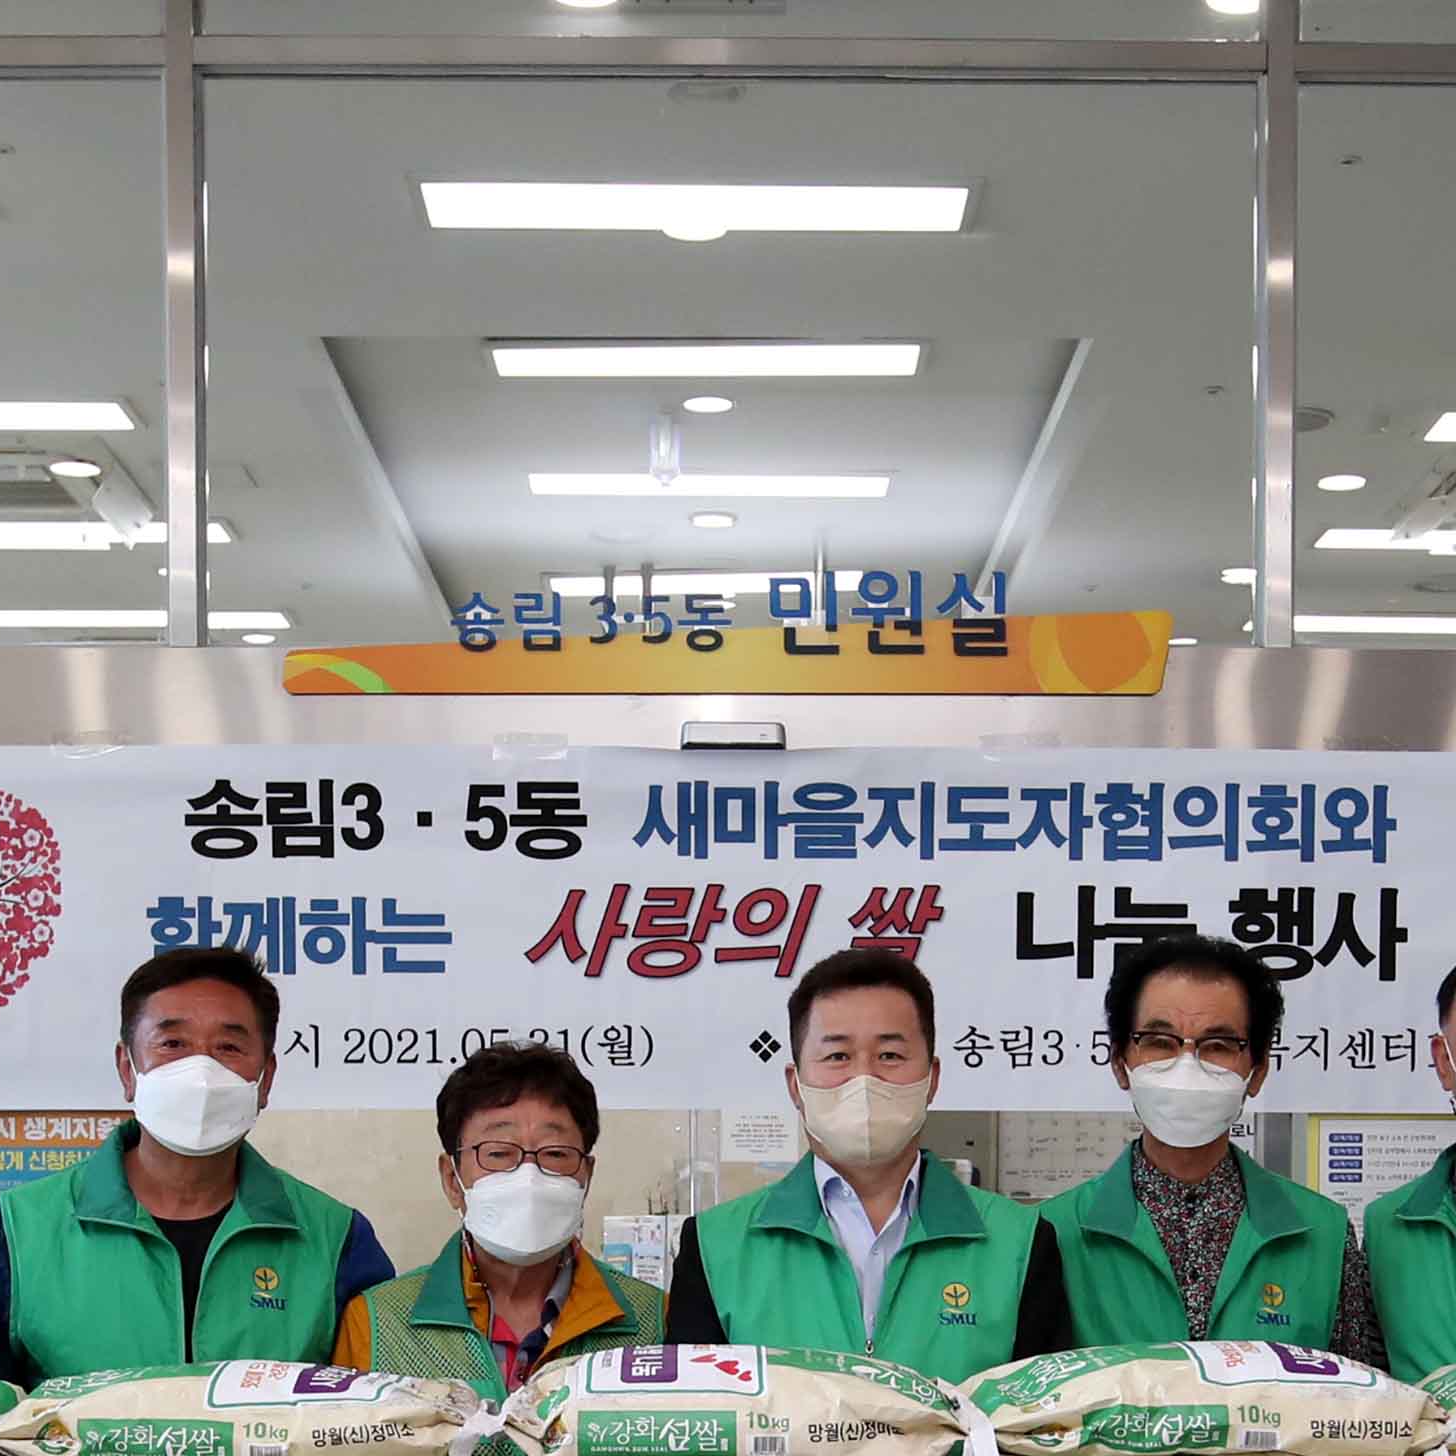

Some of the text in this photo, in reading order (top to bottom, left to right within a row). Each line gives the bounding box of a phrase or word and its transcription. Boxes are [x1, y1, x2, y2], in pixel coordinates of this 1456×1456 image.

[450, 591, 563, 652] 송림
[768, 570, 1009, 657] 민원실
[184, 778, 385, 859] 송림3
[463, 780, 588, 860] 5동
[632, 780, 1398, 864] 새마을지도자협의회와
[146, 896, 452, 975] 함께하는
[523, 883, 822, 978] 사랑의
[847, 884, 945, 962] 쌀
[1228, 886, 1408, 982] 행사
[241, 1422, 290, 1443] 10kg
[311, 1423, 415, 1447] 망월(신)정미소
